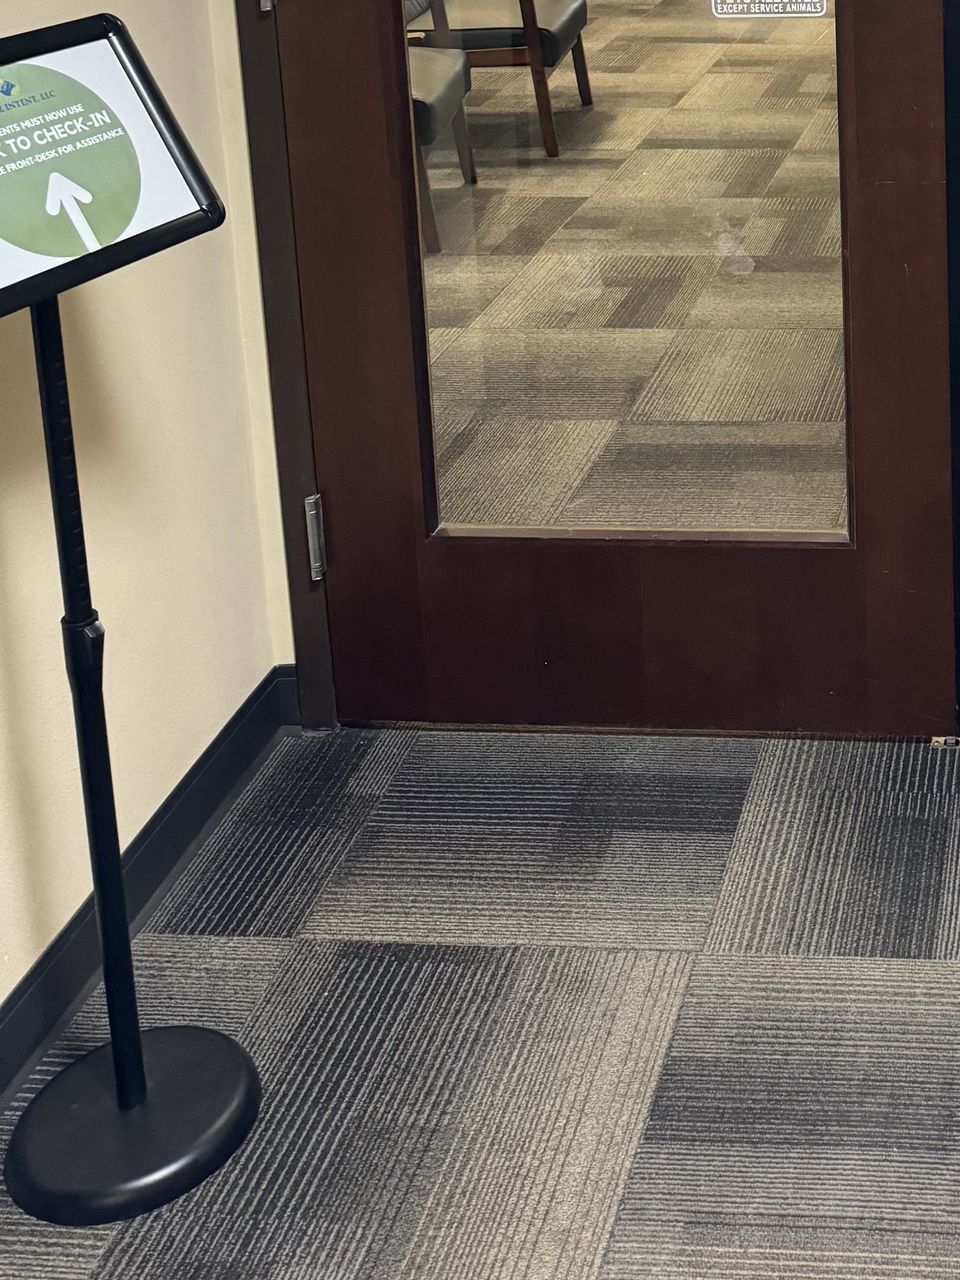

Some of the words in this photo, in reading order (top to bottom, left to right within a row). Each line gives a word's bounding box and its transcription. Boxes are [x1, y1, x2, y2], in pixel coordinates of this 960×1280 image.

[718, 4, 747, 13] EXCEPT
[751, 4, 783, 12] SERVICE
[786, 3, 821, 12] ANIMALS
[40, 90, 57, 100] LLC
[20, 116, 45, 129] MUST
[45, 109, 67, 122] NOW
[67, 104, 85, 115] USE
[5, 136, 31, 153] TO
[33, 110, 111, 144] CHECK-IN
[5, 149, 58, 172] FRONT-DESK
[58, 144, 75, 155] FOR
[75, 128, 124, 149] ASSISTANCE
